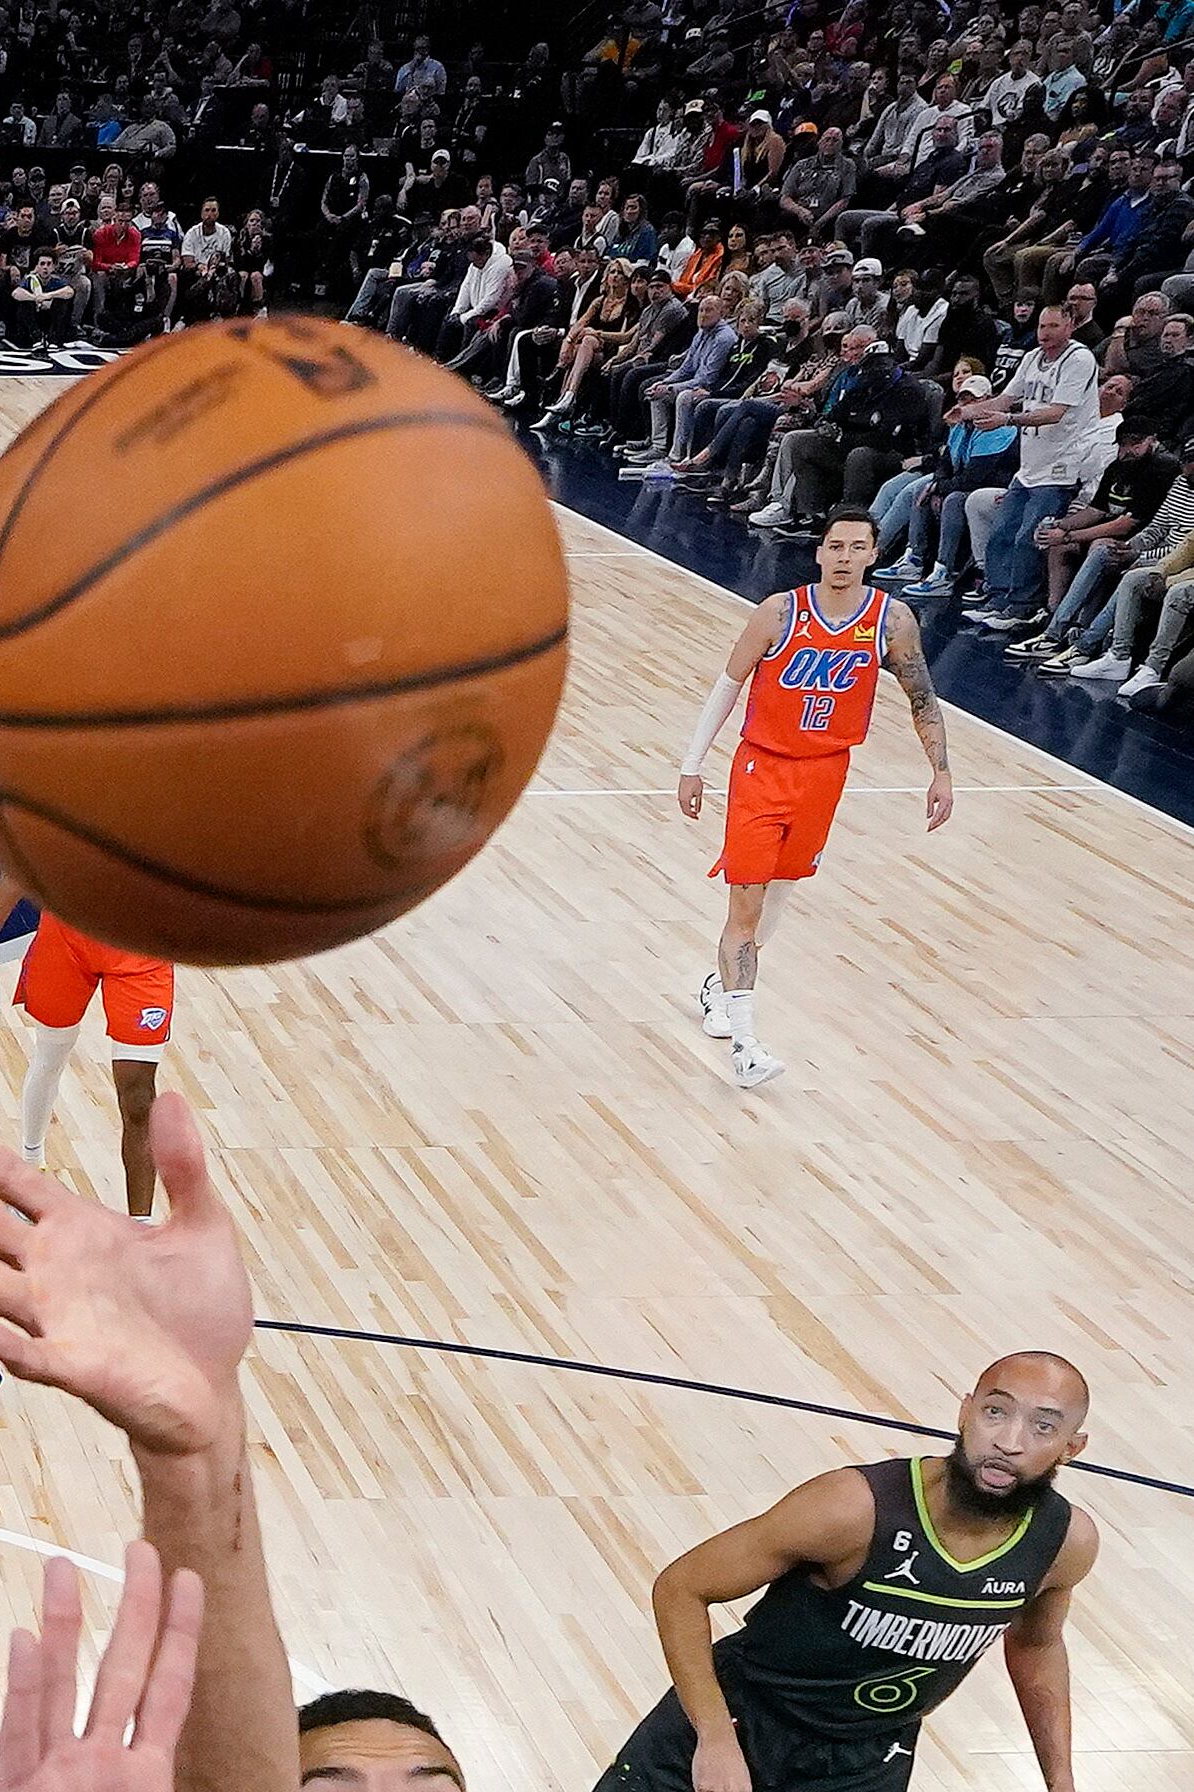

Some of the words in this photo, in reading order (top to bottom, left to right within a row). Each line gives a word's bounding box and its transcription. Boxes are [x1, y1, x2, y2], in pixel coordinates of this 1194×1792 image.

[779, 647, 871, 692] OKC
[800, 695, 835, 731] 12
[892, 1530, 913, 1551] 6
[854, 1667, 937, 1713] 6
